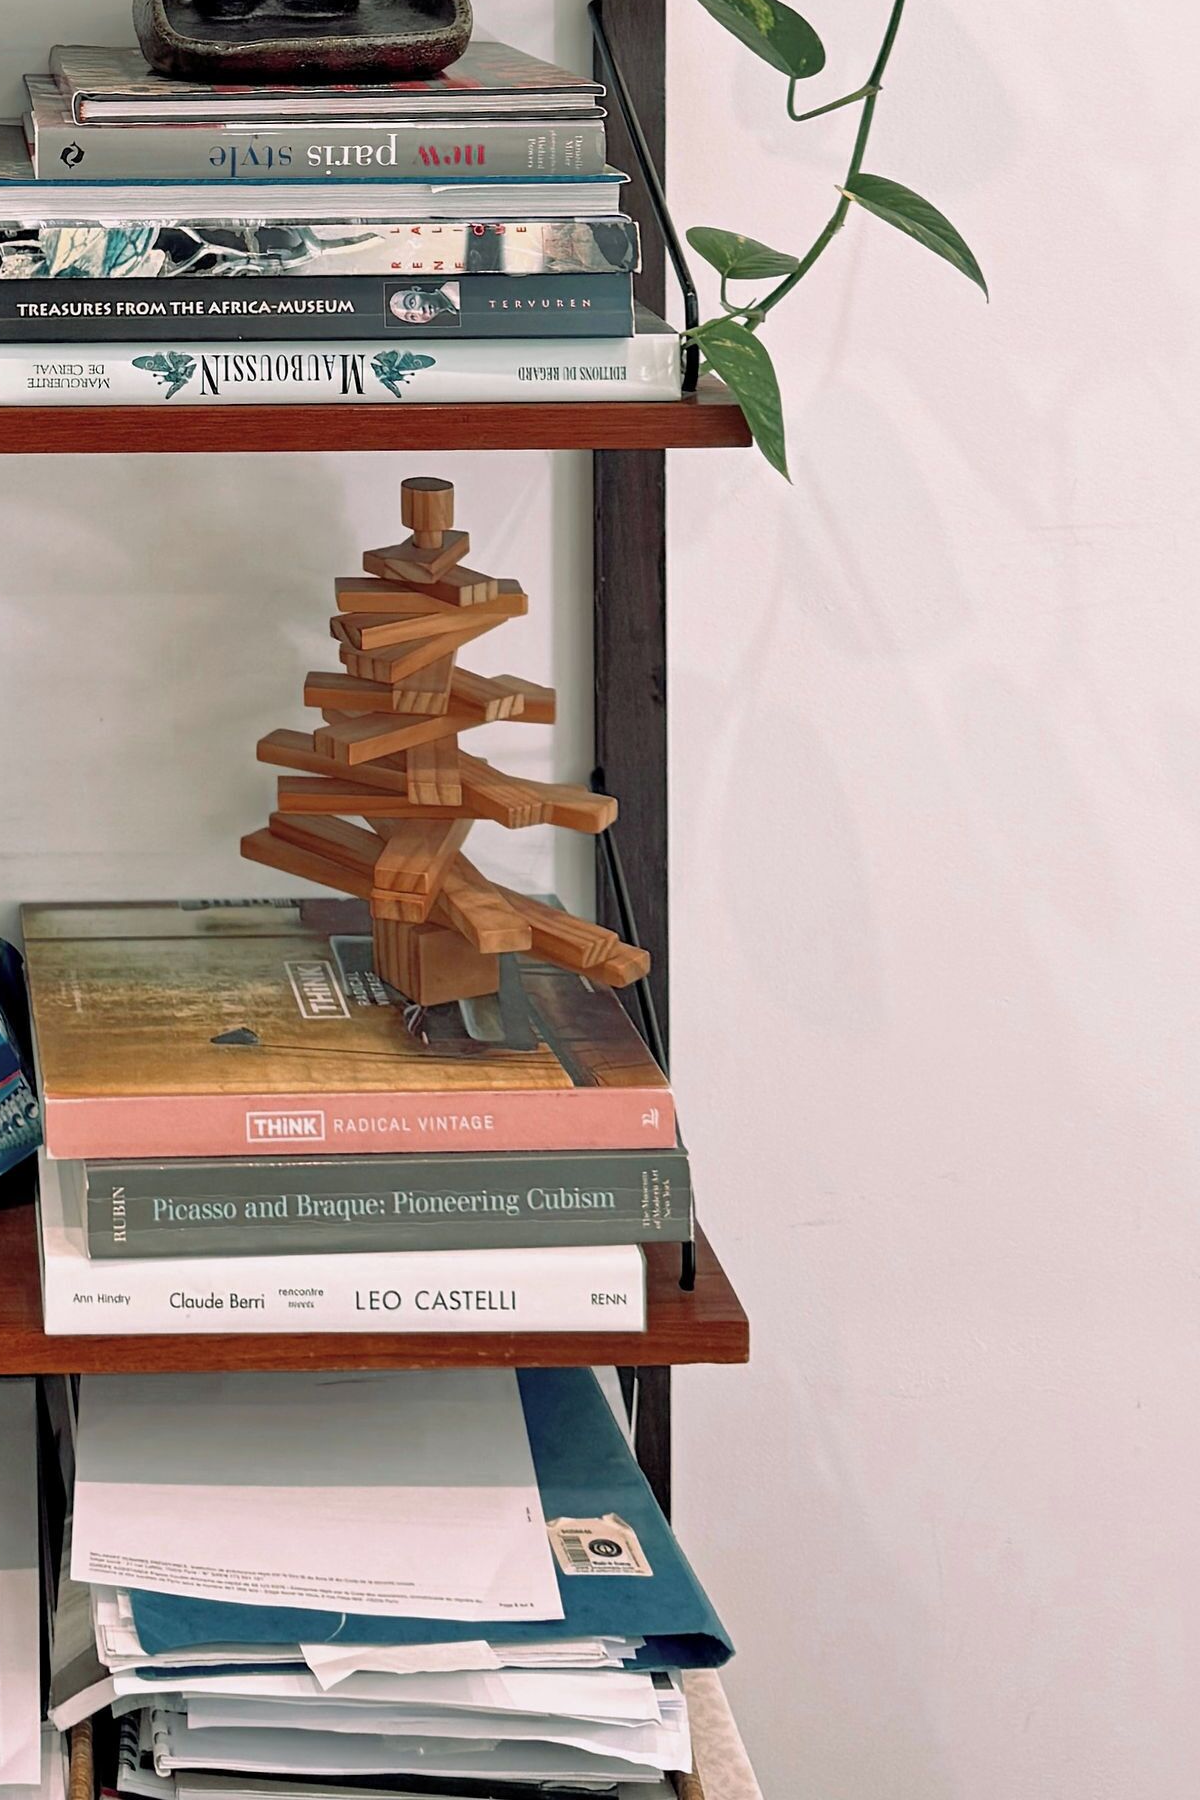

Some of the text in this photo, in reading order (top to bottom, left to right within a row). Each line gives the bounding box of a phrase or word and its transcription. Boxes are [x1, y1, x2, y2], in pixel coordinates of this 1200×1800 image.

[208, 133, 484, 176] new paris style
[16, 300, 354, 316] TREASURES FROM THE AFRICA-MUSEUM
[488, 299, 590, 309] TERVUREN
[32, 364, 104, 375] DE CERVAL
[518, 366, 626, 380] EDITIONS DU REGARD
[27, 377, 110, 389] MARGUERITE
[333, 1113, 493, 1133] RADICAL VINTAGE
[153, 1198, 236, 1221] Picasso
[244, 1195, 288, 1218] and
[391, 1189, 519, 1216] Pioneering
[526, 1185, 615, 1210] Cubism
[112, 1186, 126, 1241] RUBIN
[169, 1291, 264, 1308] Claude Berri
[355, 1290, 515, 1310] LEO CASTELLI
[590, 1293, 626, 1305] RENN
